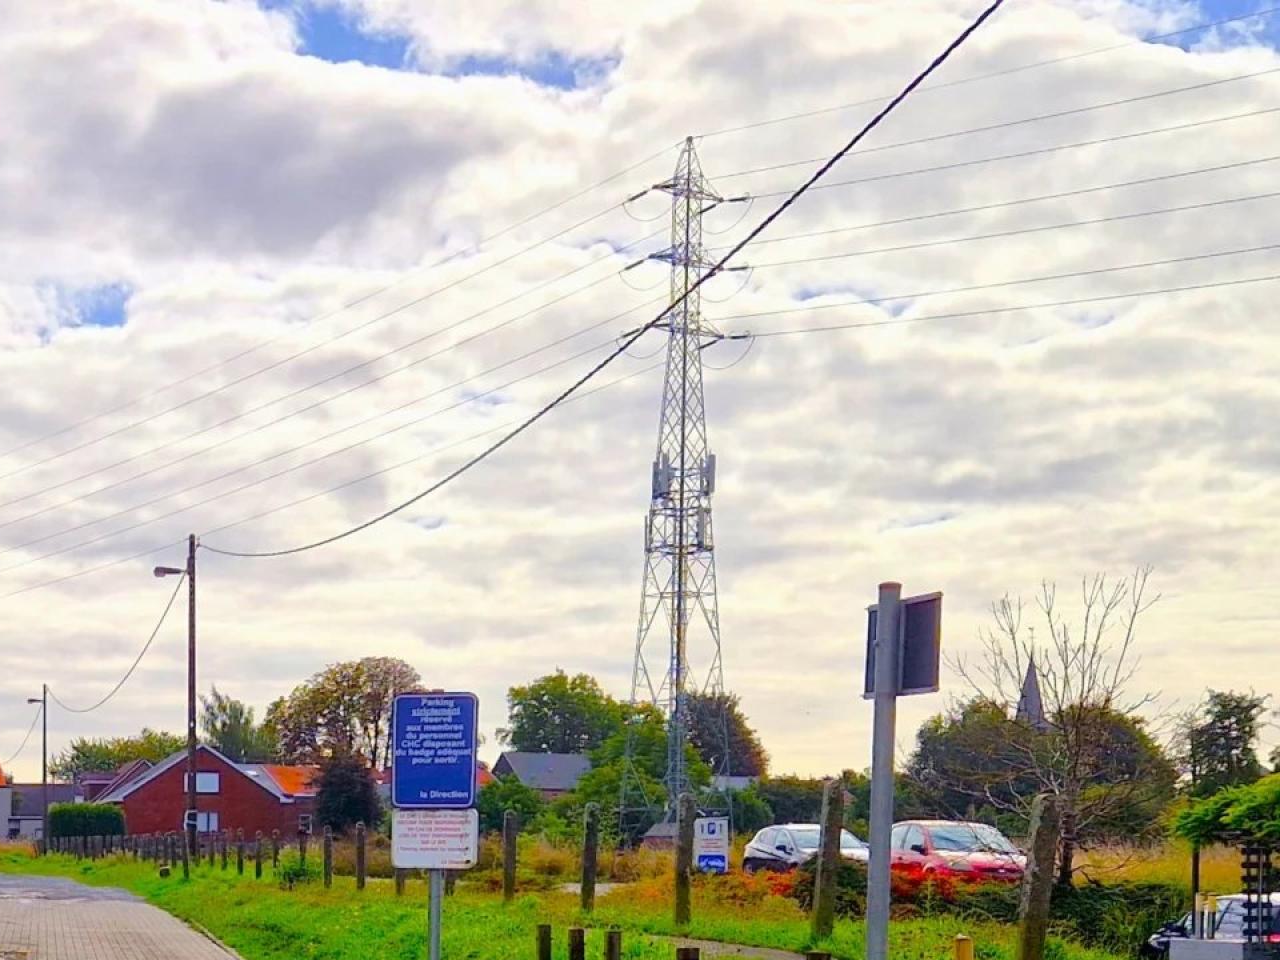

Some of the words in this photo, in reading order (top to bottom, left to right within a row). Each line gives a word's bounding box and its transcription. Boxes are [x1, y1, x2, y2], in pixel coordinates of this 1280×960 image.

[420, 698, 454, 707] Parking
[424, 723, 464, 731] membres
[405, 731, 417, 739] du
[419, 731, 462, 740] personnel
[423, 739, 465, 749] disposant
[408, 747, 435, 757] badge
[412, 757, 432, 765] pour
[430, 790, 469, 799] Direction
